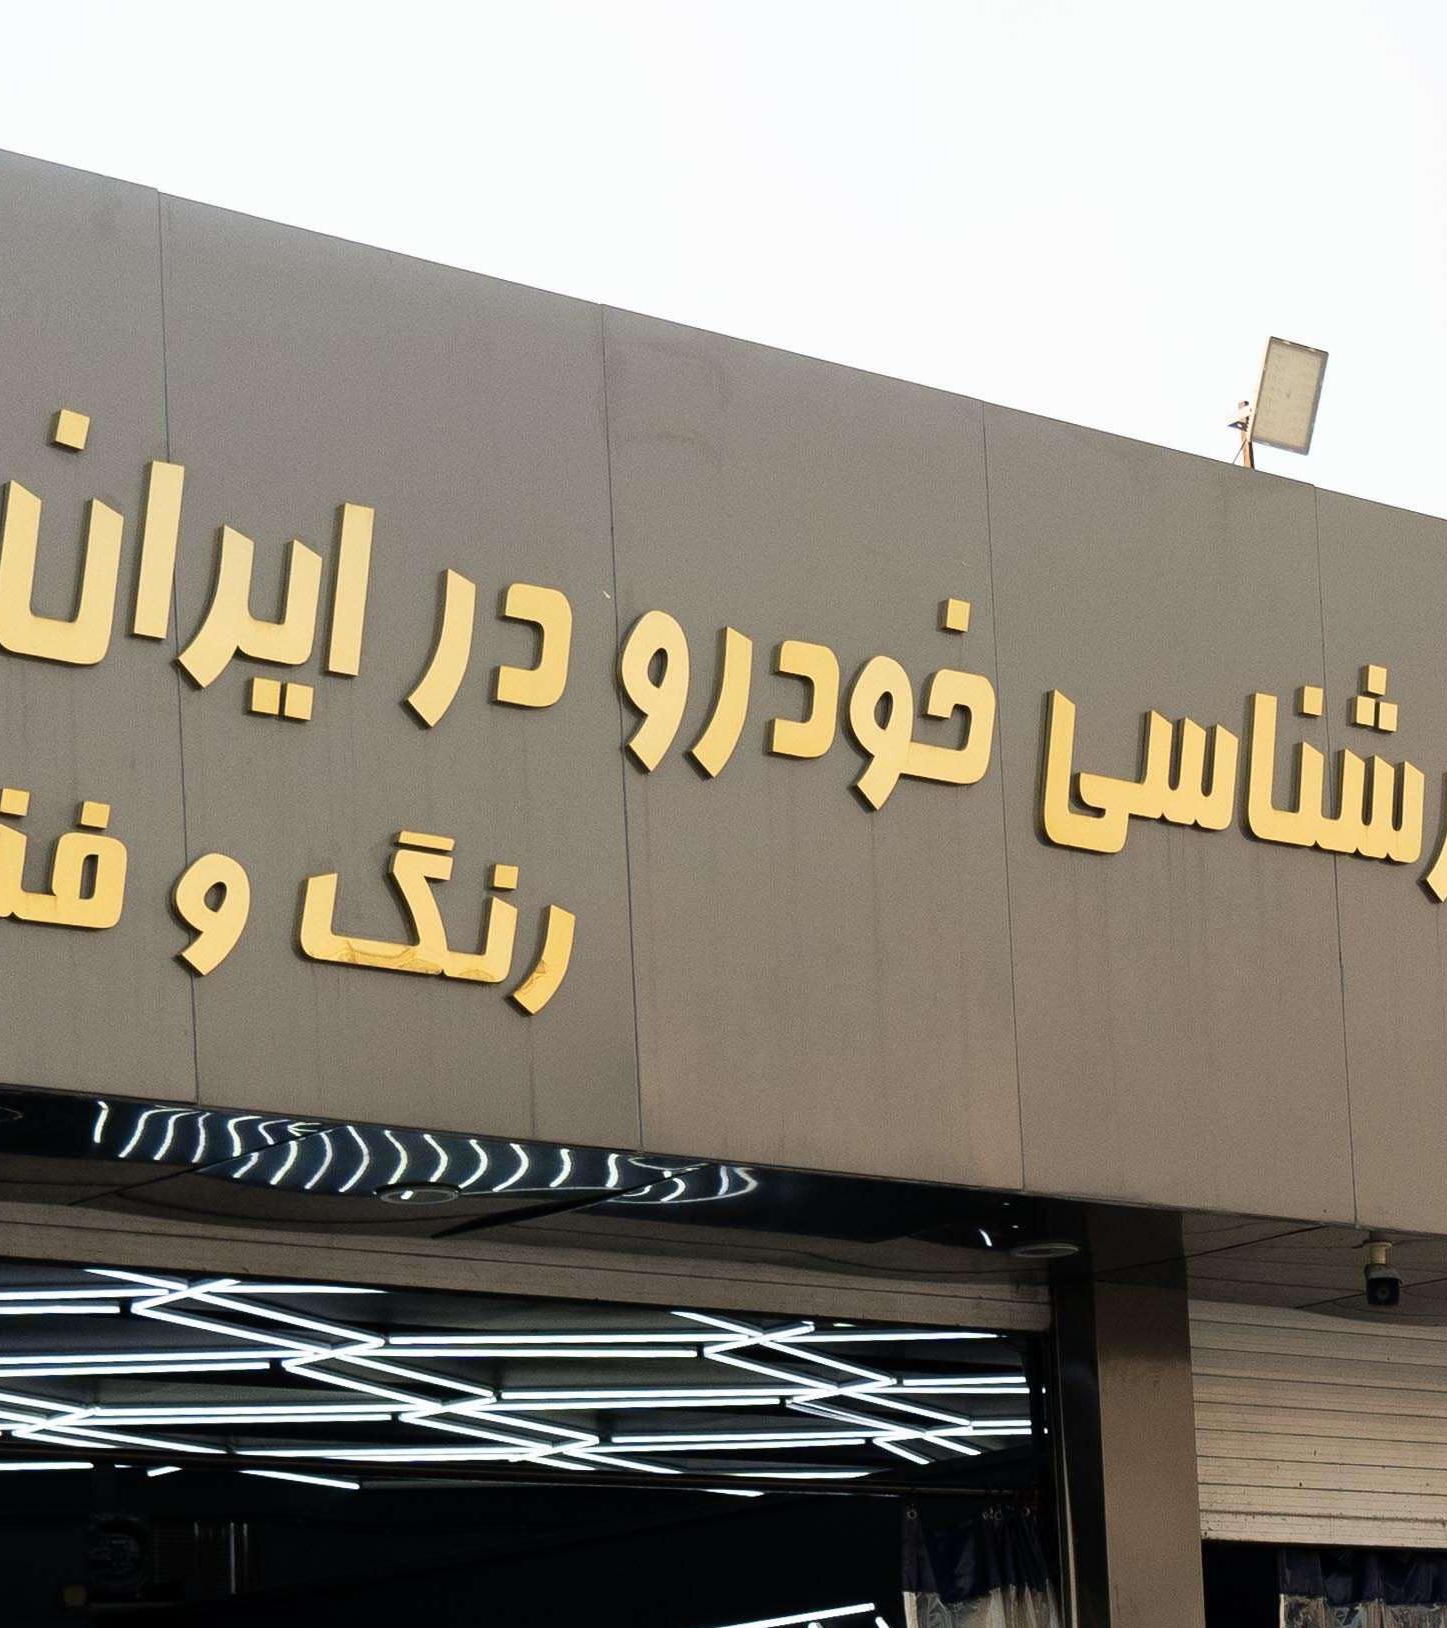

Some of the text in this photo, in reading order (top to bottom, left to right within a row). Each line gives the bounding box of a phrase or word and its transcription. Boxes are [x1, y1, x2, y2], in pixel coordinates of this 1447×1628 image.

[408, 567, 573, 728] در
[620, 598, 996, 810] خودرو
[172, 852, 251, 975] و
[299, 831, 575, 1014] رنگ
